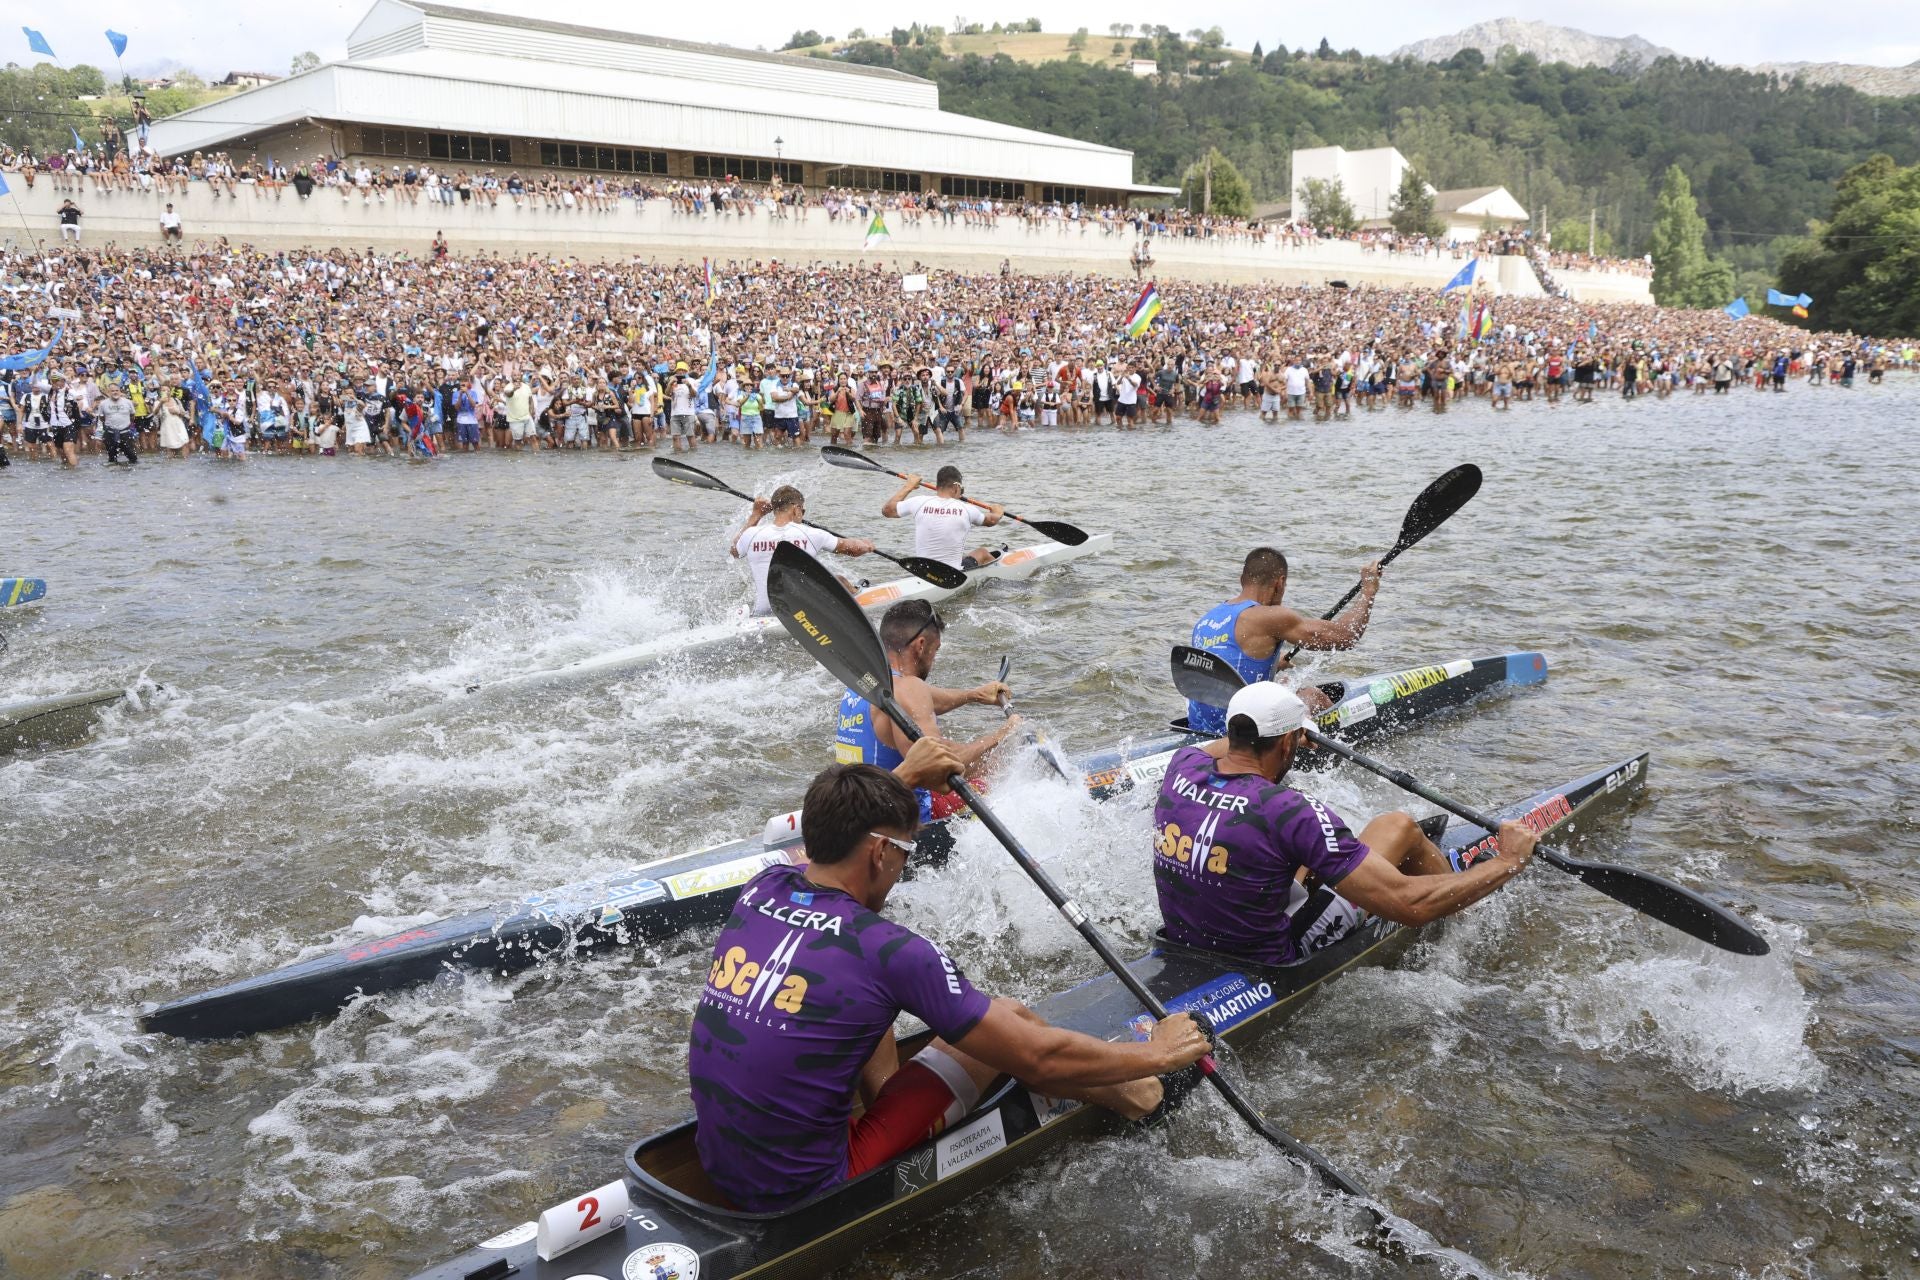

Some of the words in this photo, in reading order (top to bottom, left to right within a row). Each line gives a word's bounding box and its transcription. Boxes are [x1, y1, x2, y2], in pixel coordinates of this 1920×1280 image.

[923, 505, 963, 516] HUNGARY
[753, 540, 808, 552] HUNRY
[816, 634, 832, 646] IV
[1172, 773, 1248, 814] WALTER
[787, 814, 796, 831] 1
[739, 886, 752, 905] A.
[758, 897, 843, 936] LLERA
[1205, 982, 1272, 1026] MARTINO
[949, 1126, 991, 1153] FISIOTERAPIA
[947, 1149, 974, 1167] VALERA
[577, 1196, 601, 1232] 2
